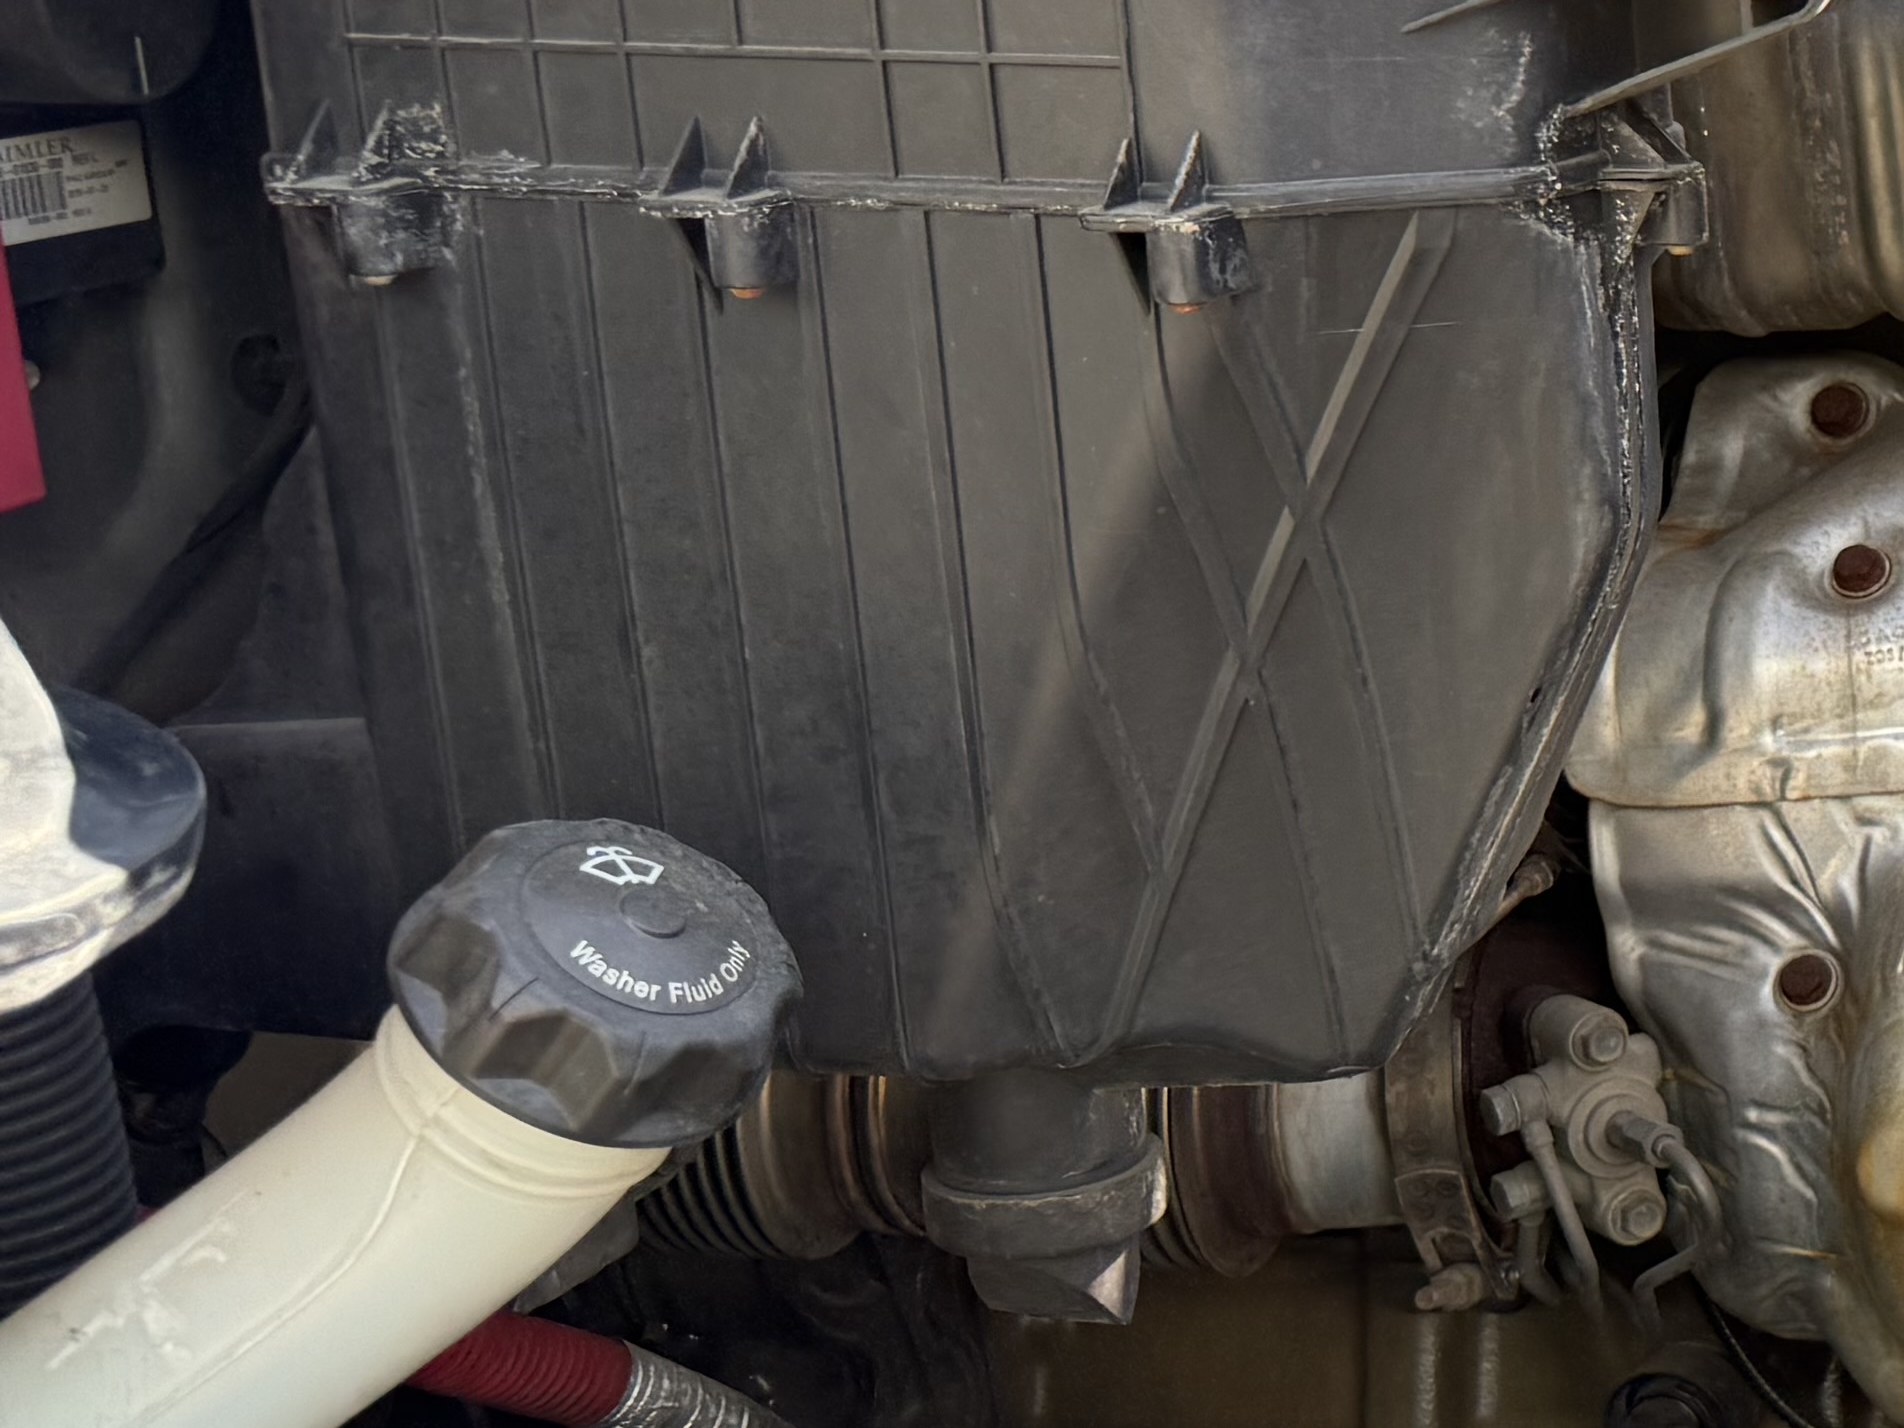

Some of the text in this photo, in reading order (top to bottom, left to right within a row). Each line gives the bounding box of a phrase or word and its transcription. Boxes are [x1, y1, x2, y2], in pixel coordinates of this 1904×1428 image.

[569, 939, 751, 1004] Washer Fluid Only
